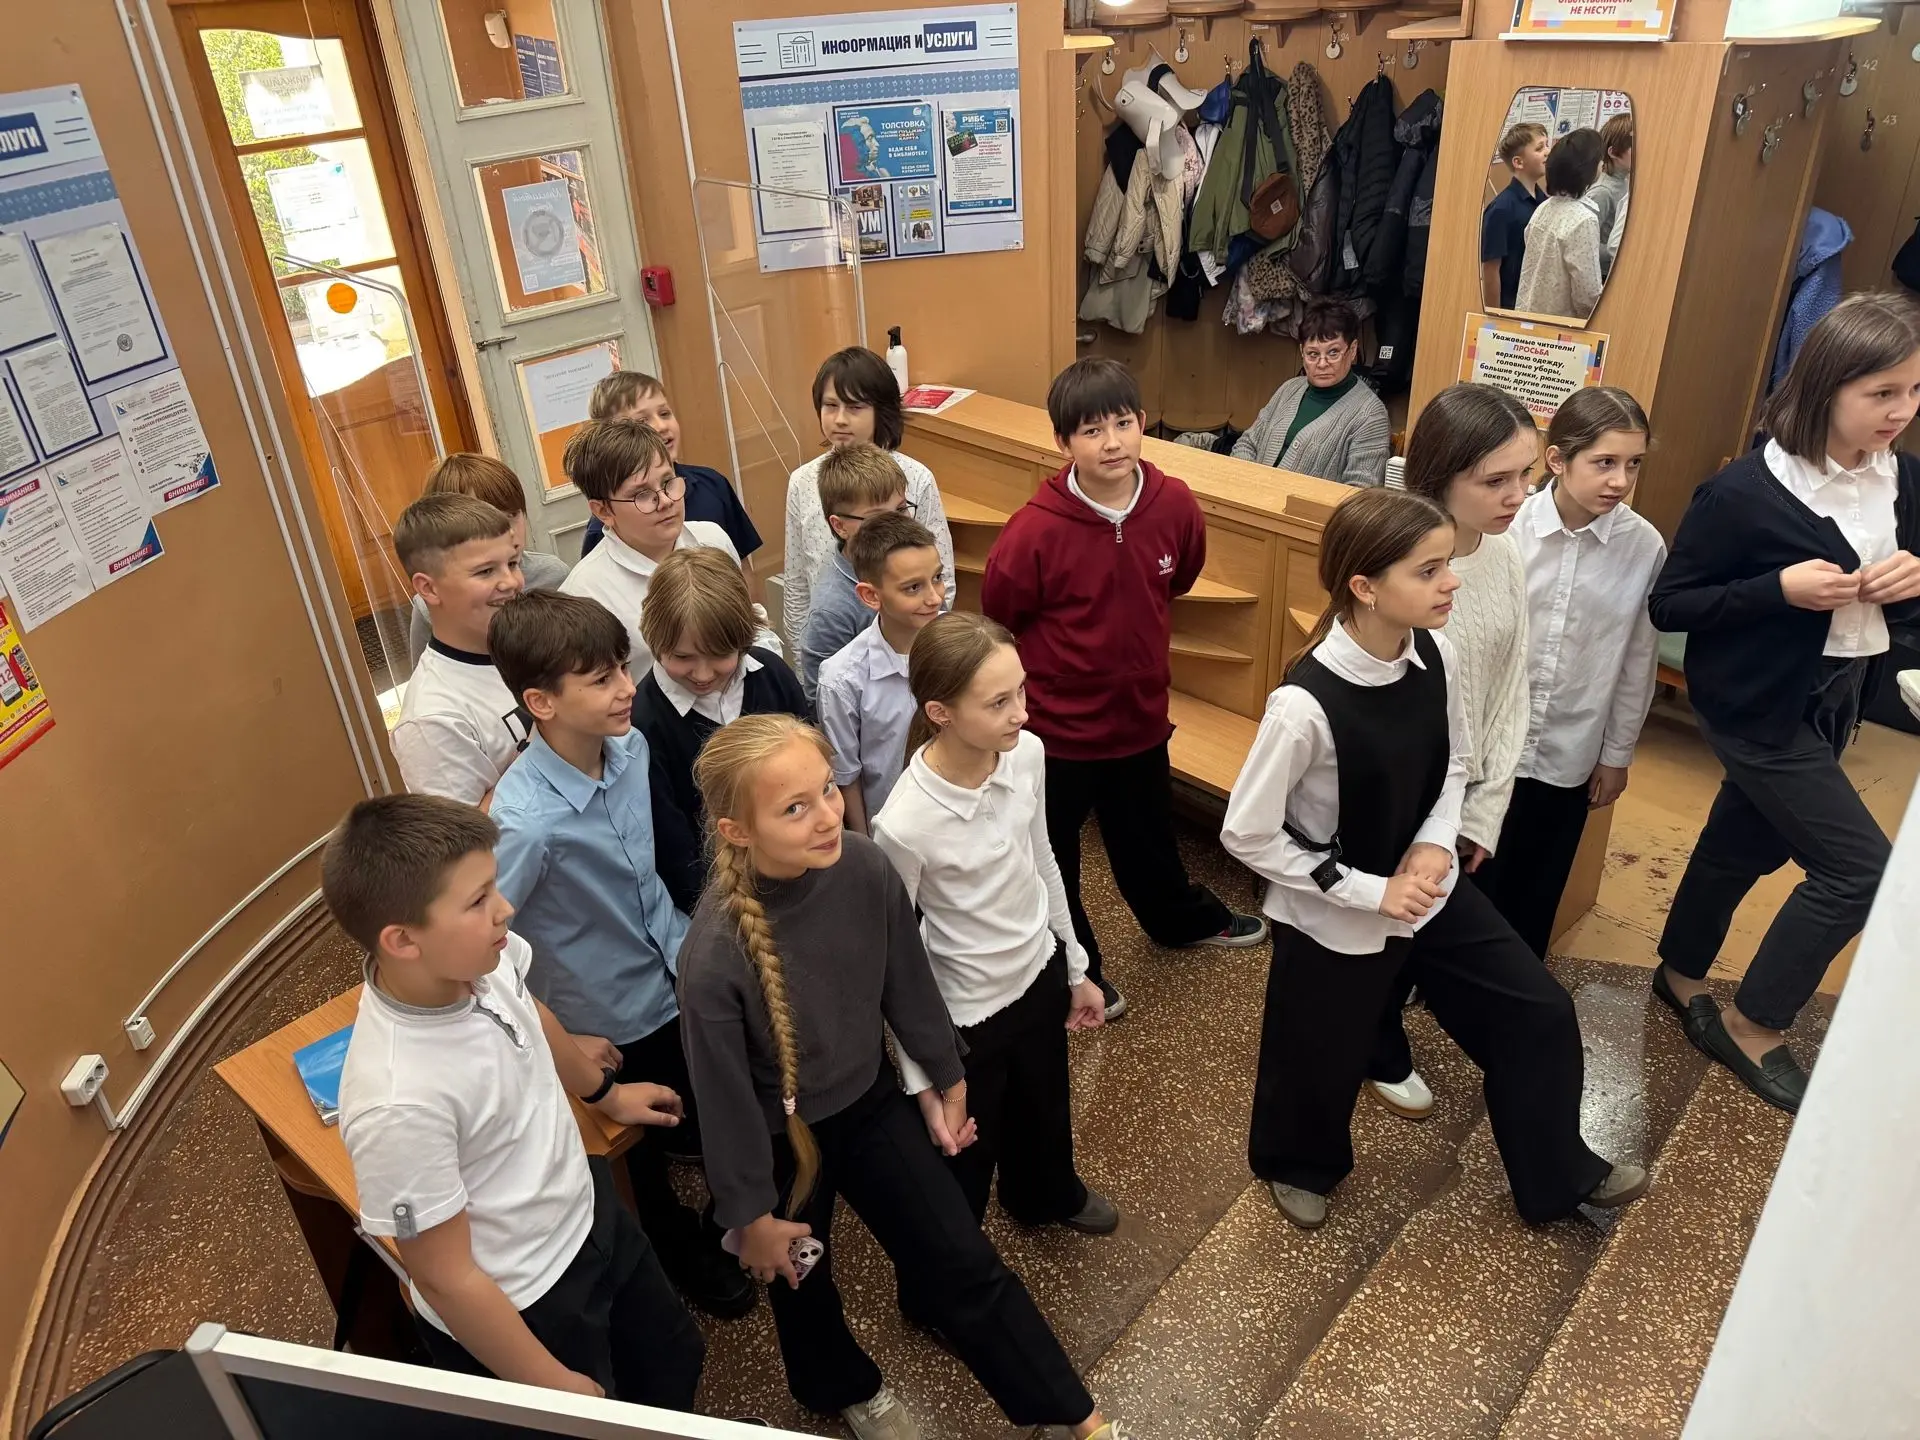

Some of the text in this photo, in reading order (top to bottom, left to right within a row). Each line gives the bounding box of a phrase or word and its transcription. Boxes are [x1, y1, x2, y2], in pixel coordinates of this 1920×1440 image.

[1570, 6, 1616, 14] НЕ НЕСУТ!
[822, 31, 973, 55] ИНФОРМАЦИЯ И УСЛУГИ
[1232, 60, 1242, 70] 20
[1862, 59, 1878, 71] 42
[881, 120, 925, 129] ТОЛСТОВКА
[962, 115, 985, 123] РИБС
[1882, 115, 1897, 125] 43
[1492, 333, 1576, 352] Уважаемые читатели!
[1513, 345, 1549, 357] ПРОСЬБА
[1496, 351, 1565, 368] верхнюю одежду,
[1496, 359, 1562, 376] головные уборы,
[1480, 362, 1577, 387] большие сумки, рюкзаки,
[1483, 372, 1571, 393] пакеты, другие личные
[1519, 387, 1559, 399] сторонние
[1526, 397, 1559, 407] издания
[168, 479, 205, 500] ВНИМАНИЕ!
[113, 547, 149, 570] ВНИМАНИЕ!
